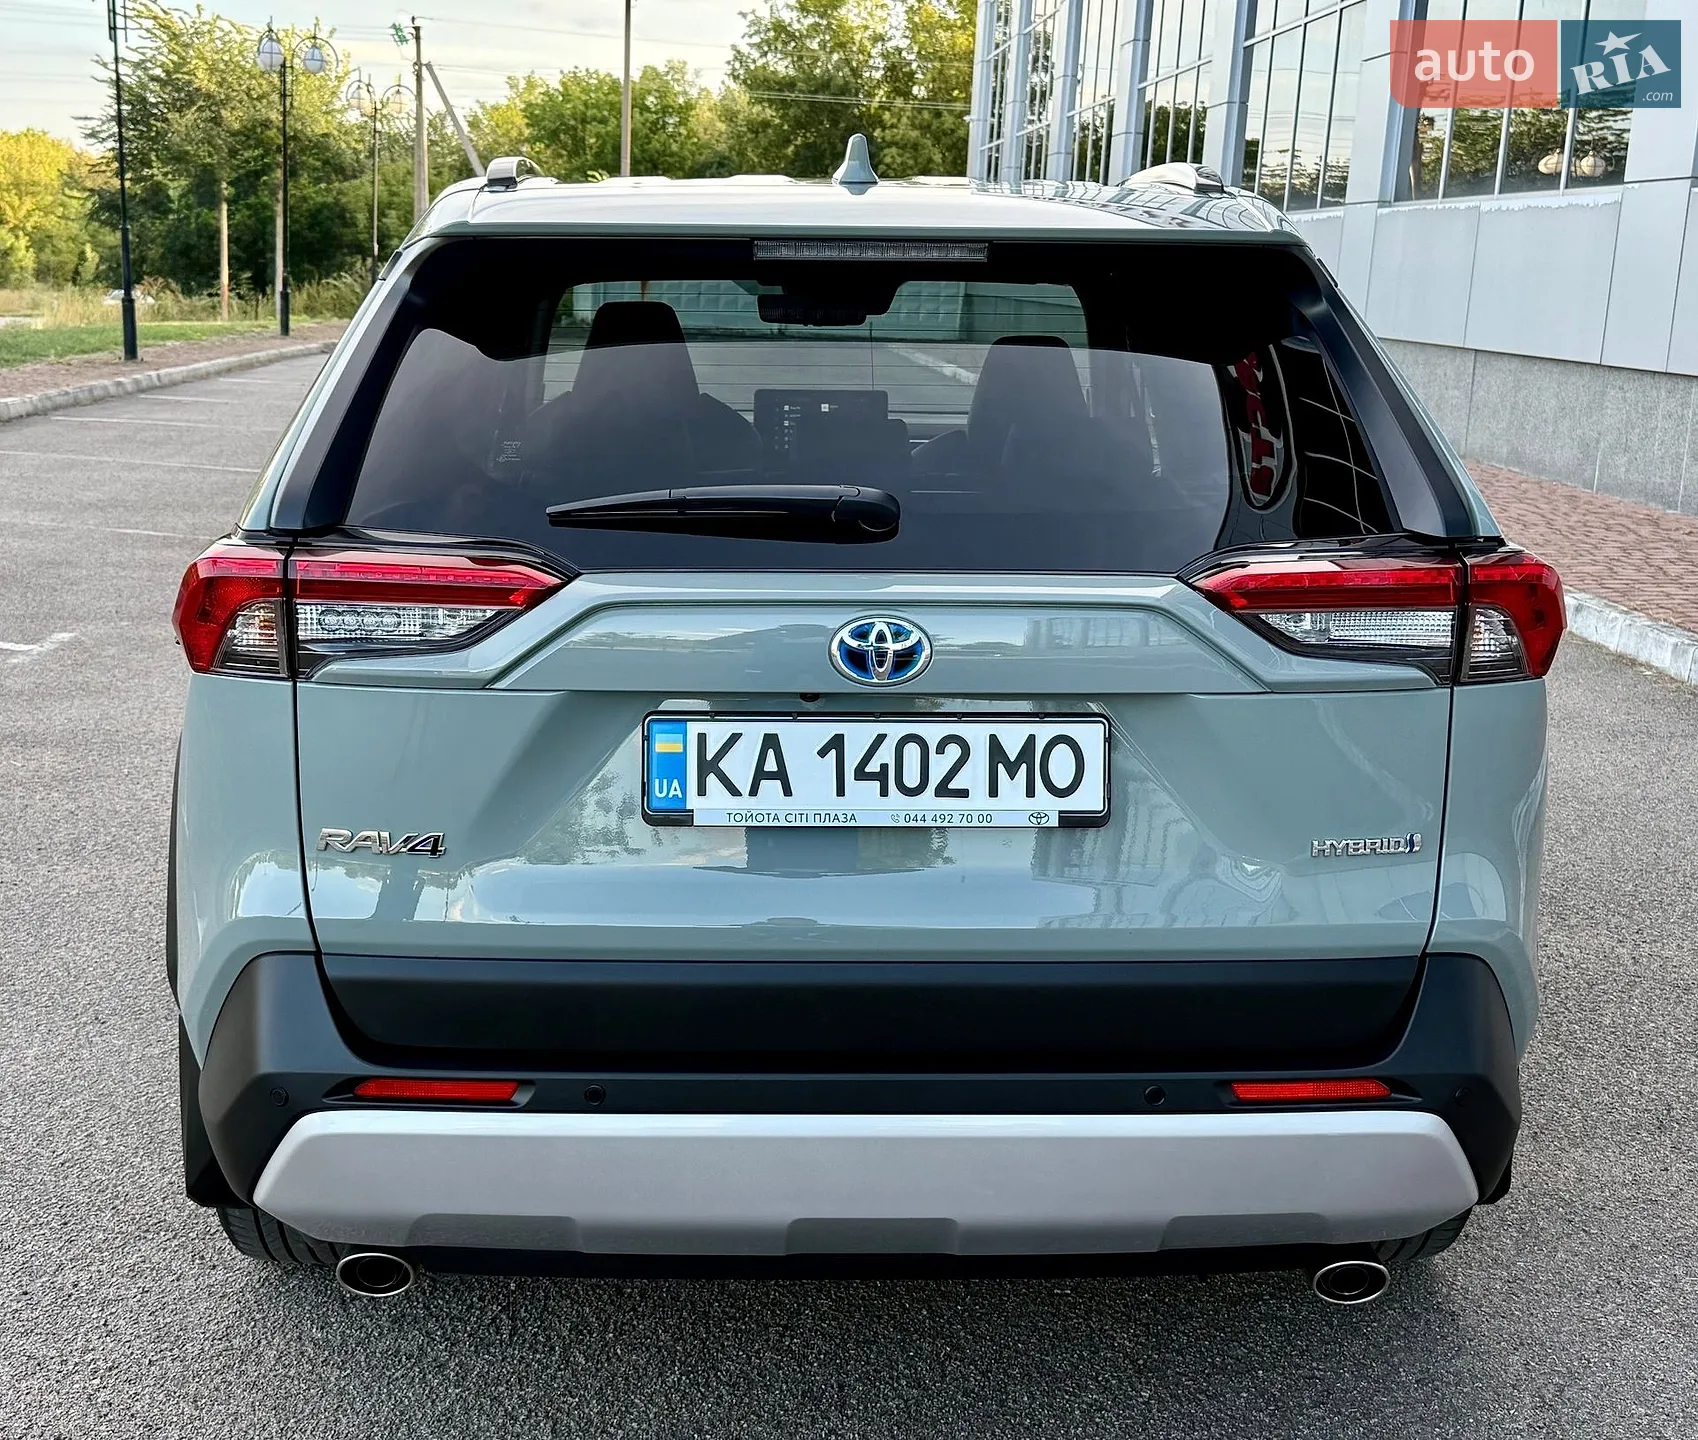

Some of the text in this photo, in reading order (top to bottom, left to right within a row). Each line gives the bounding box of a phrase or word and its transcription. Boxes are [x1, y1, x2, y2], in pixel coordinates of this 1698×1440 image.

[696, 732, 1086, 799] KA 1402 MO
[654, 778, 683, 799] UA
[726, 810, 780, 823] ТОЙОТА
[813, 813, 858, 823] ПЛАЗА
[904, 813, 993, 824] 044 492 70 00
[317, 828, 446, 858] RAV4
[1312, 838, 1405, 857] HYBRID
